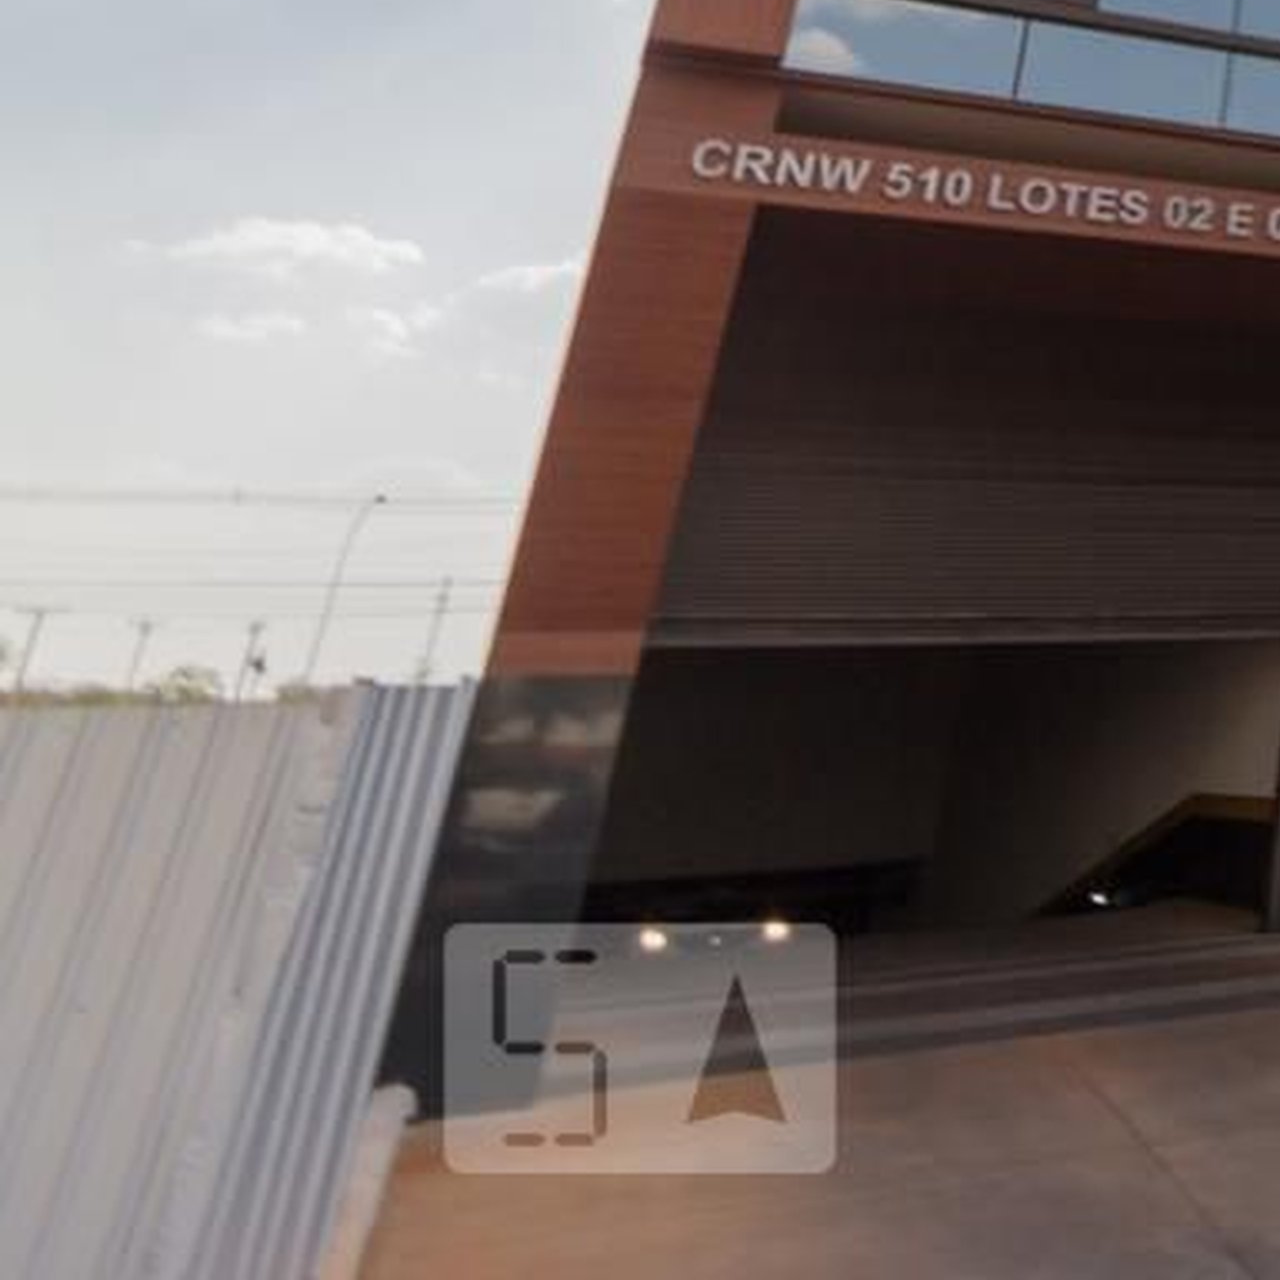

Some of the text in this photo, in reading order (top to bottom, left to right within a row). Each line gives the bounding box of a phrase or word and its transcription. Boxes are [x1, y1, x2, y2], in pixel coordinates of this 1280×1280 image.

[692, 138, 870, 194] CRNW
[881, 160, 973, 206] 510
[986, 172, 1150, 225] LOTES
[1163, 194, 1214, 231] 02
[1225, 201, 1255, 237] E
